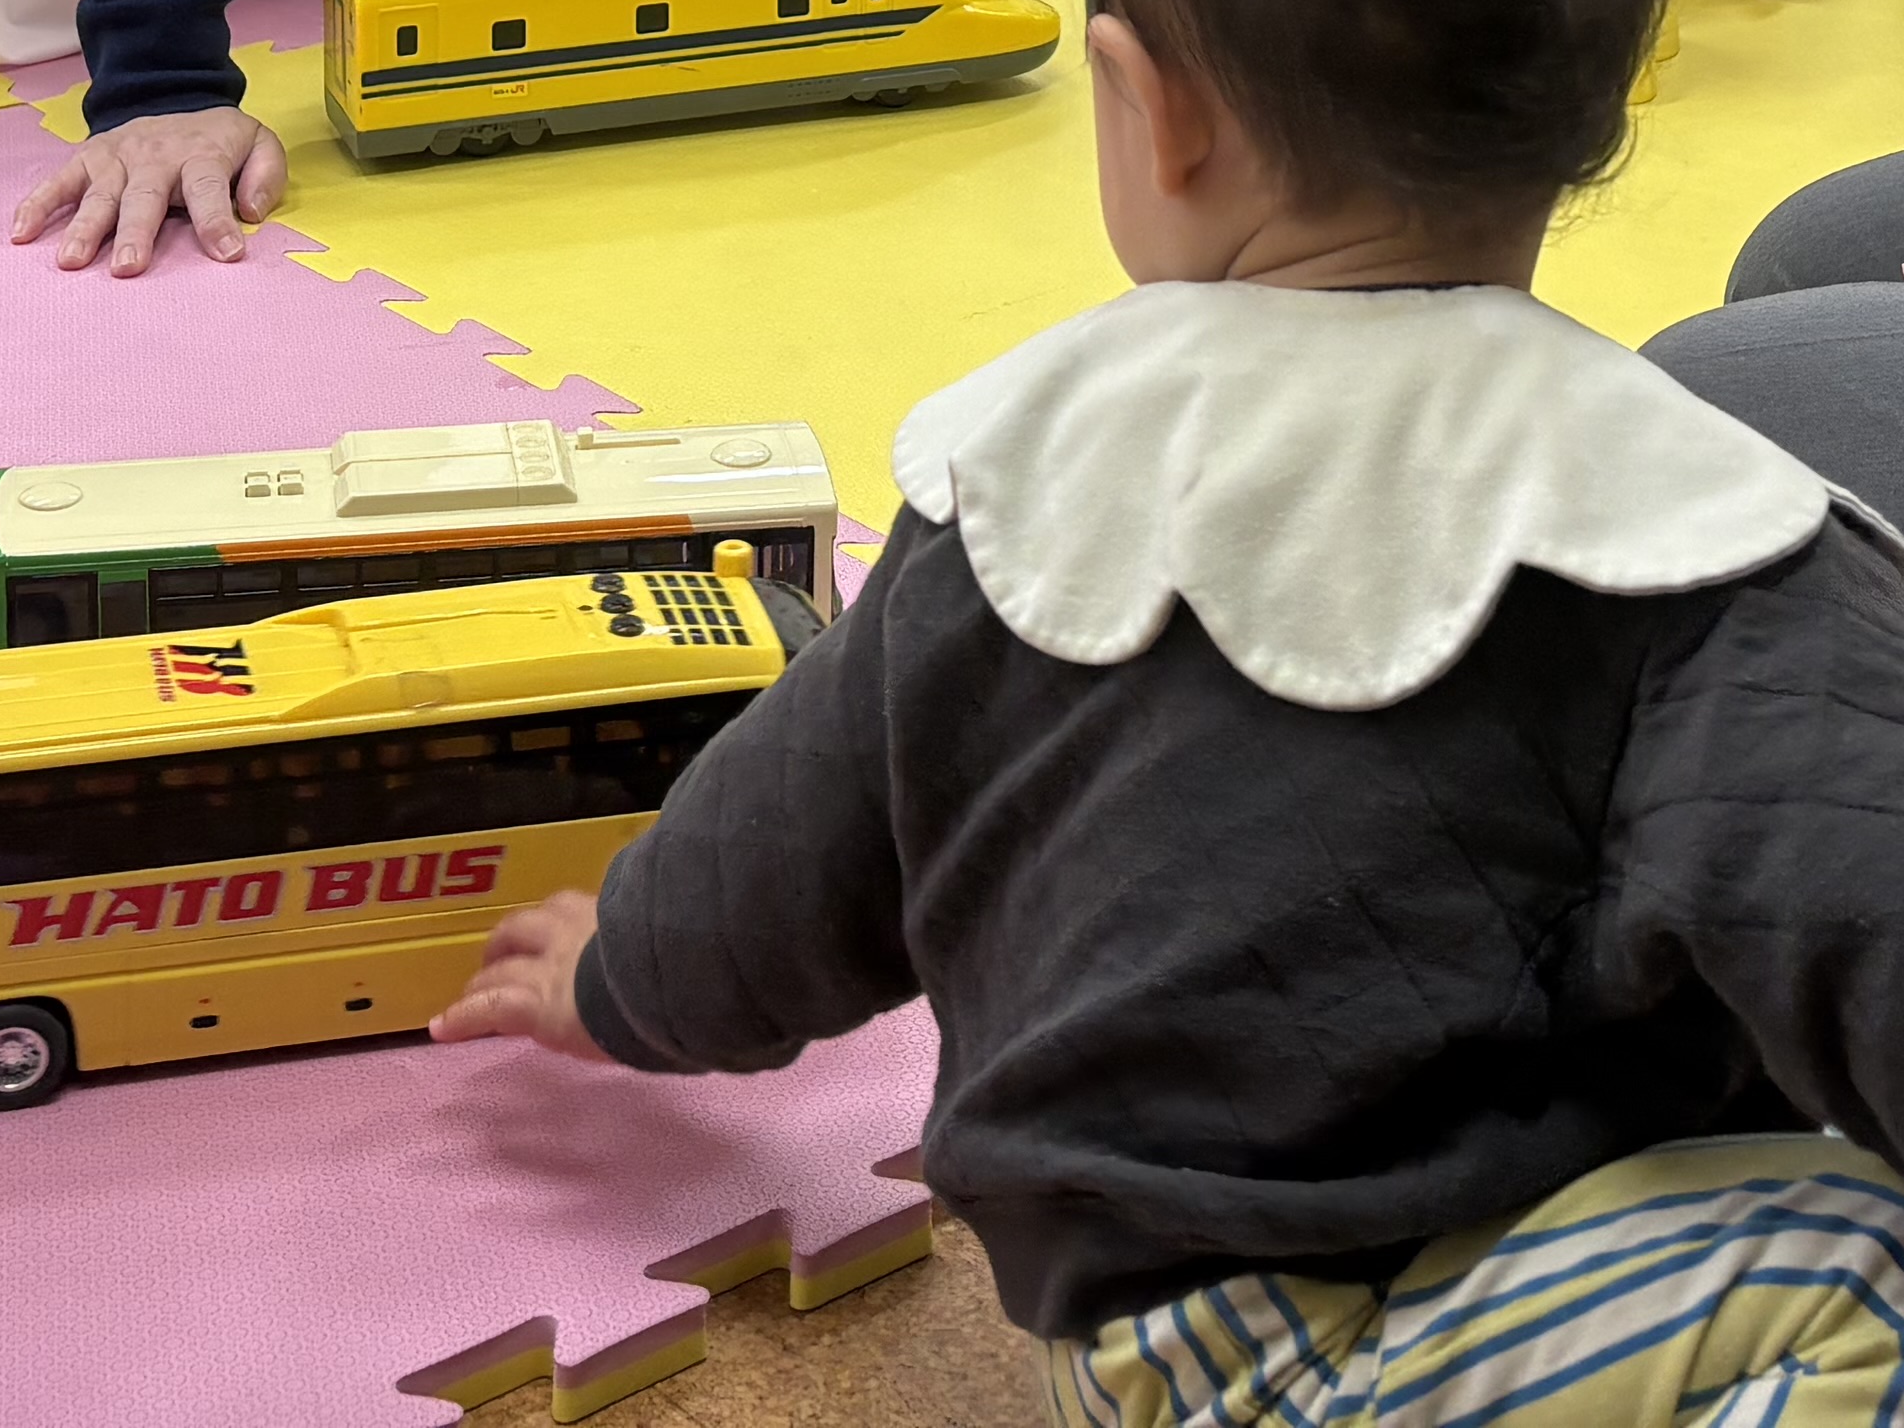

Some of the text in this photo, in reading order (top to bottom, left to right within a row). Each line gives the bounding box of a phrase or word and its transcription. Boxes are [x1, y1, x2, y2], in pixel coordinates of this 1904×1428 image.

[510, 83, 526, 95] JR
[2, 844, 506, 949] HATO BUS
